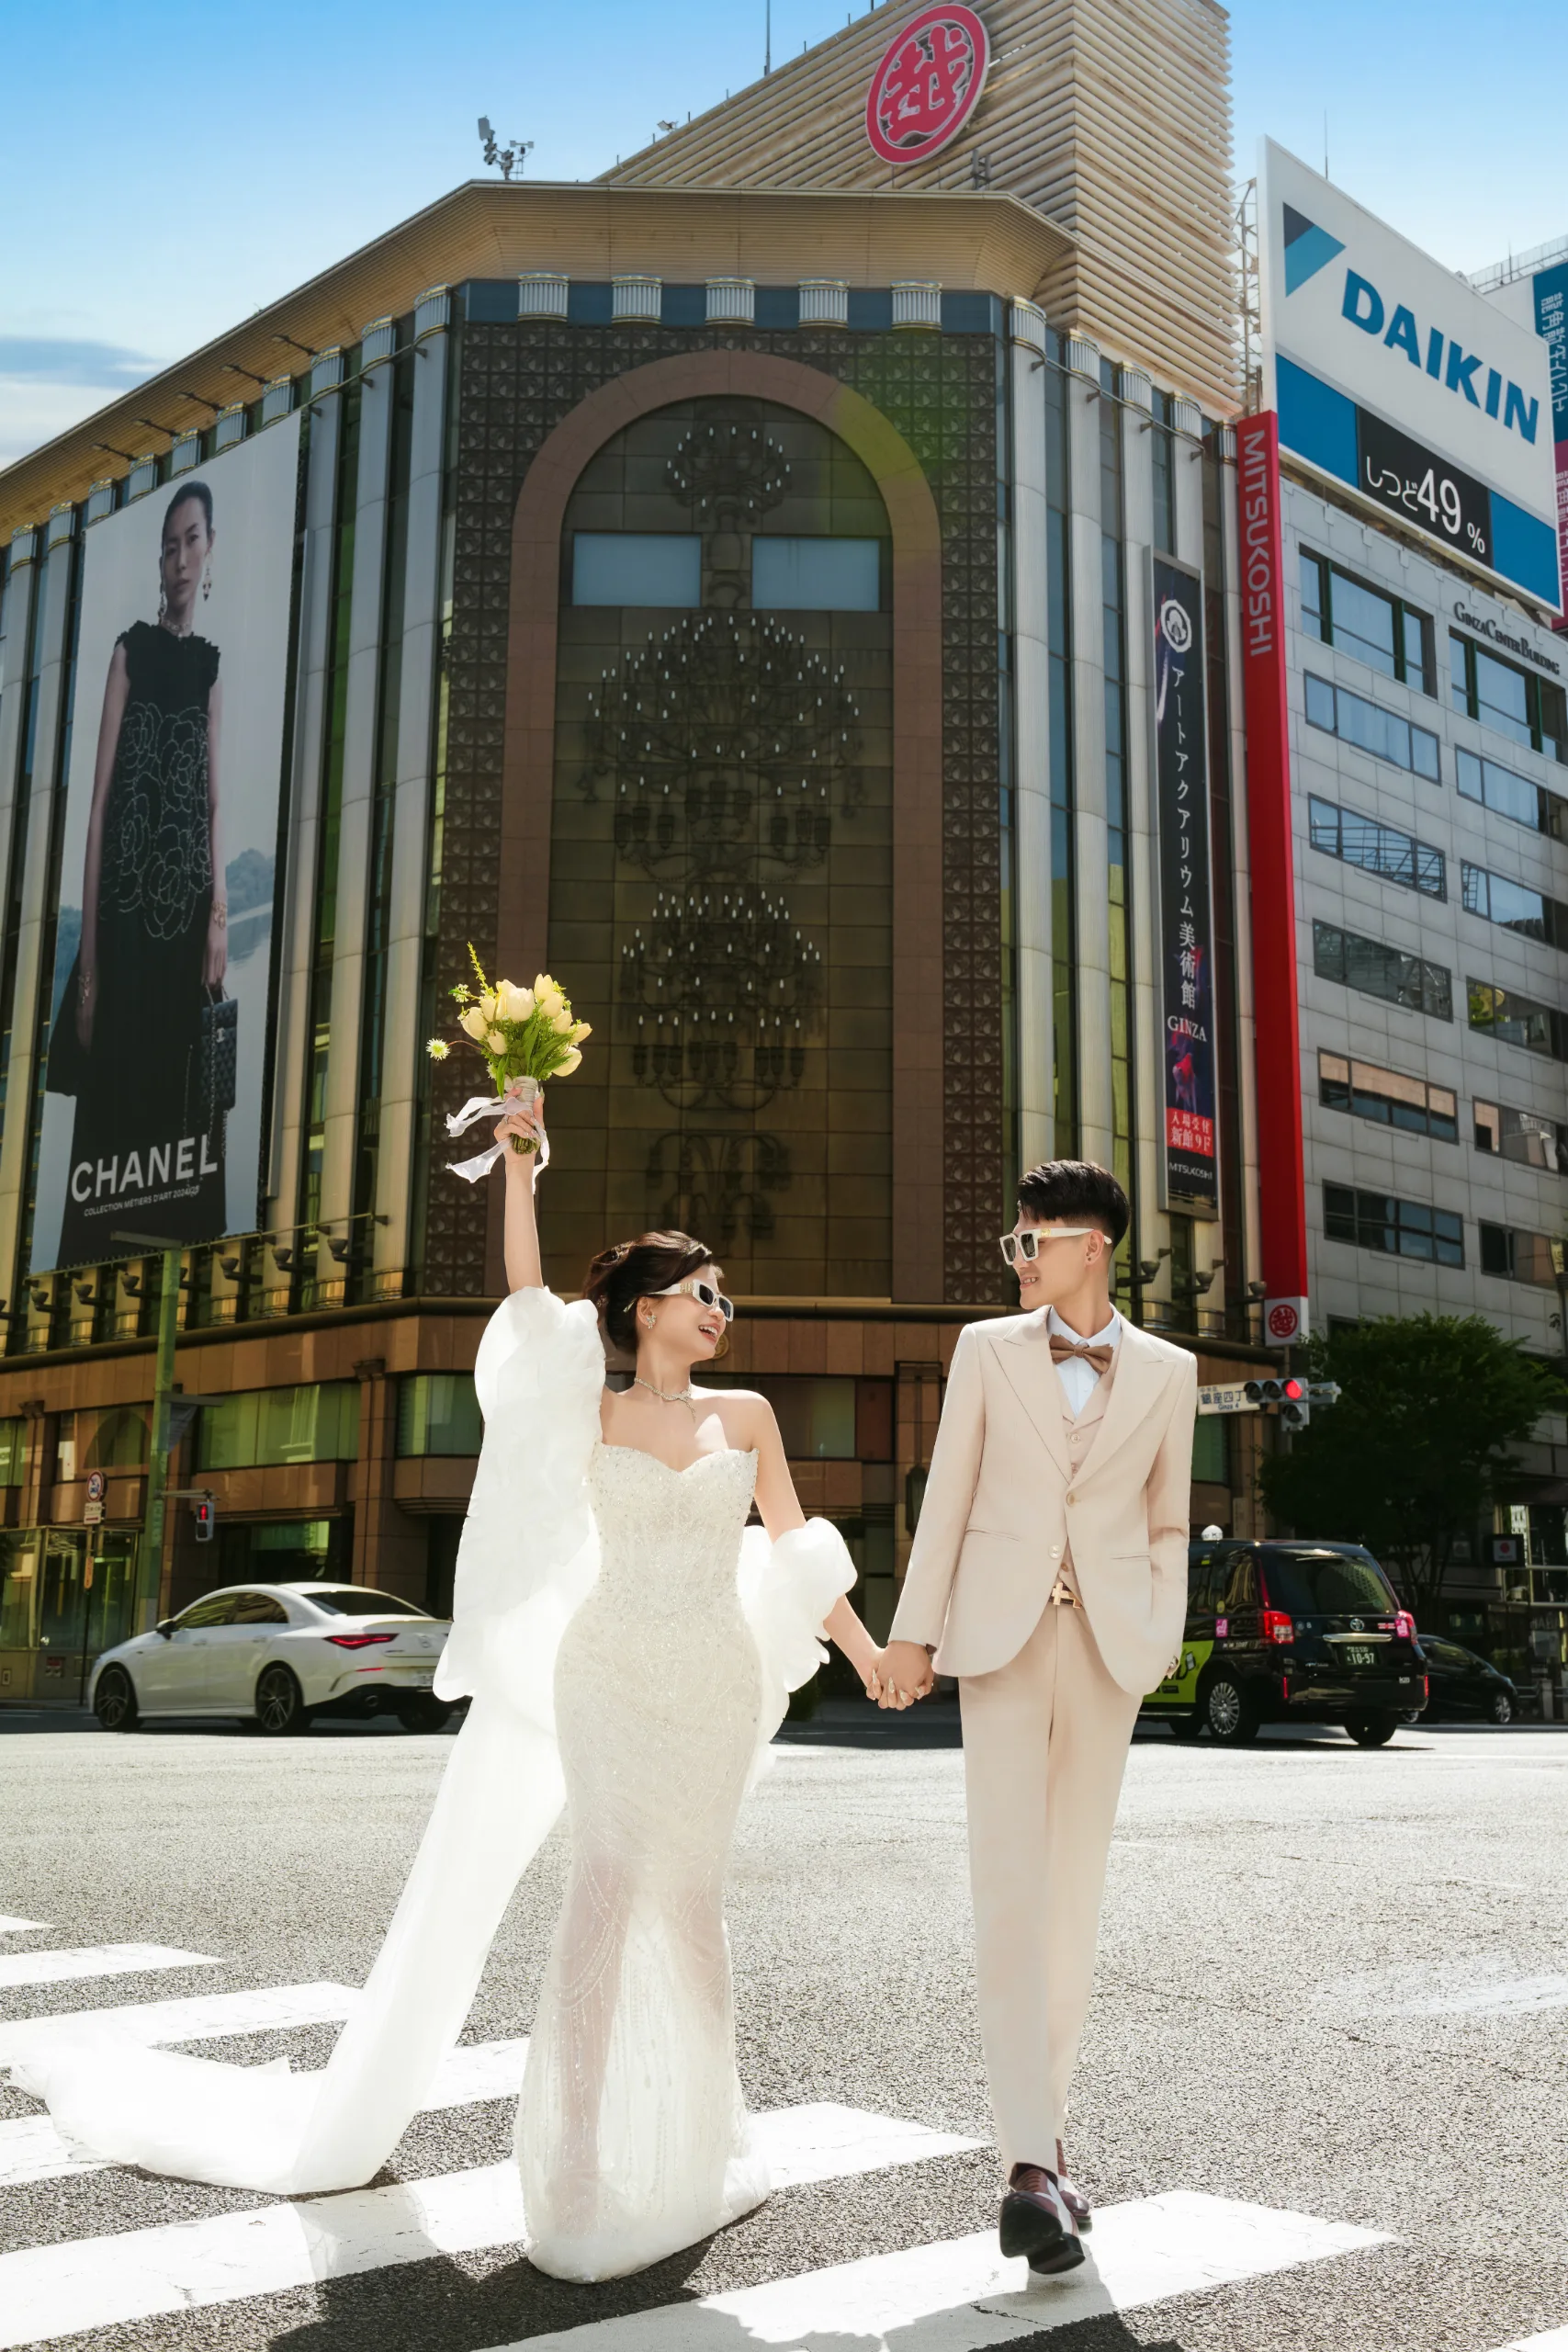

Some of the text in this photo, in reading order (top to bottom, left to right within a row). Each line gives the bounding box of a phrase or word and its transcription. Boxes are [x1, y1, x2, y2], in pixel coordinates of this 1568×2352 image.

[1341, 266, 1540, 446] DAIKIN
[1243, 429, 1273, 657] MITSUKOSHI
[1171, 665, 1197, 1010] アートアクアリウム美術館
[1167, 1014, 1208, 1043] GINZA
[71, 1133, 218, 1203] CHANEL
[1168, 1161, 1213, 1181] MITSUKOSHI
[84, 1202, 123, 1216] COLLECTION
[152, 1191, 173, 1203] D'ART
[1201, 1389, 1246, 1405] 銀座四丁
